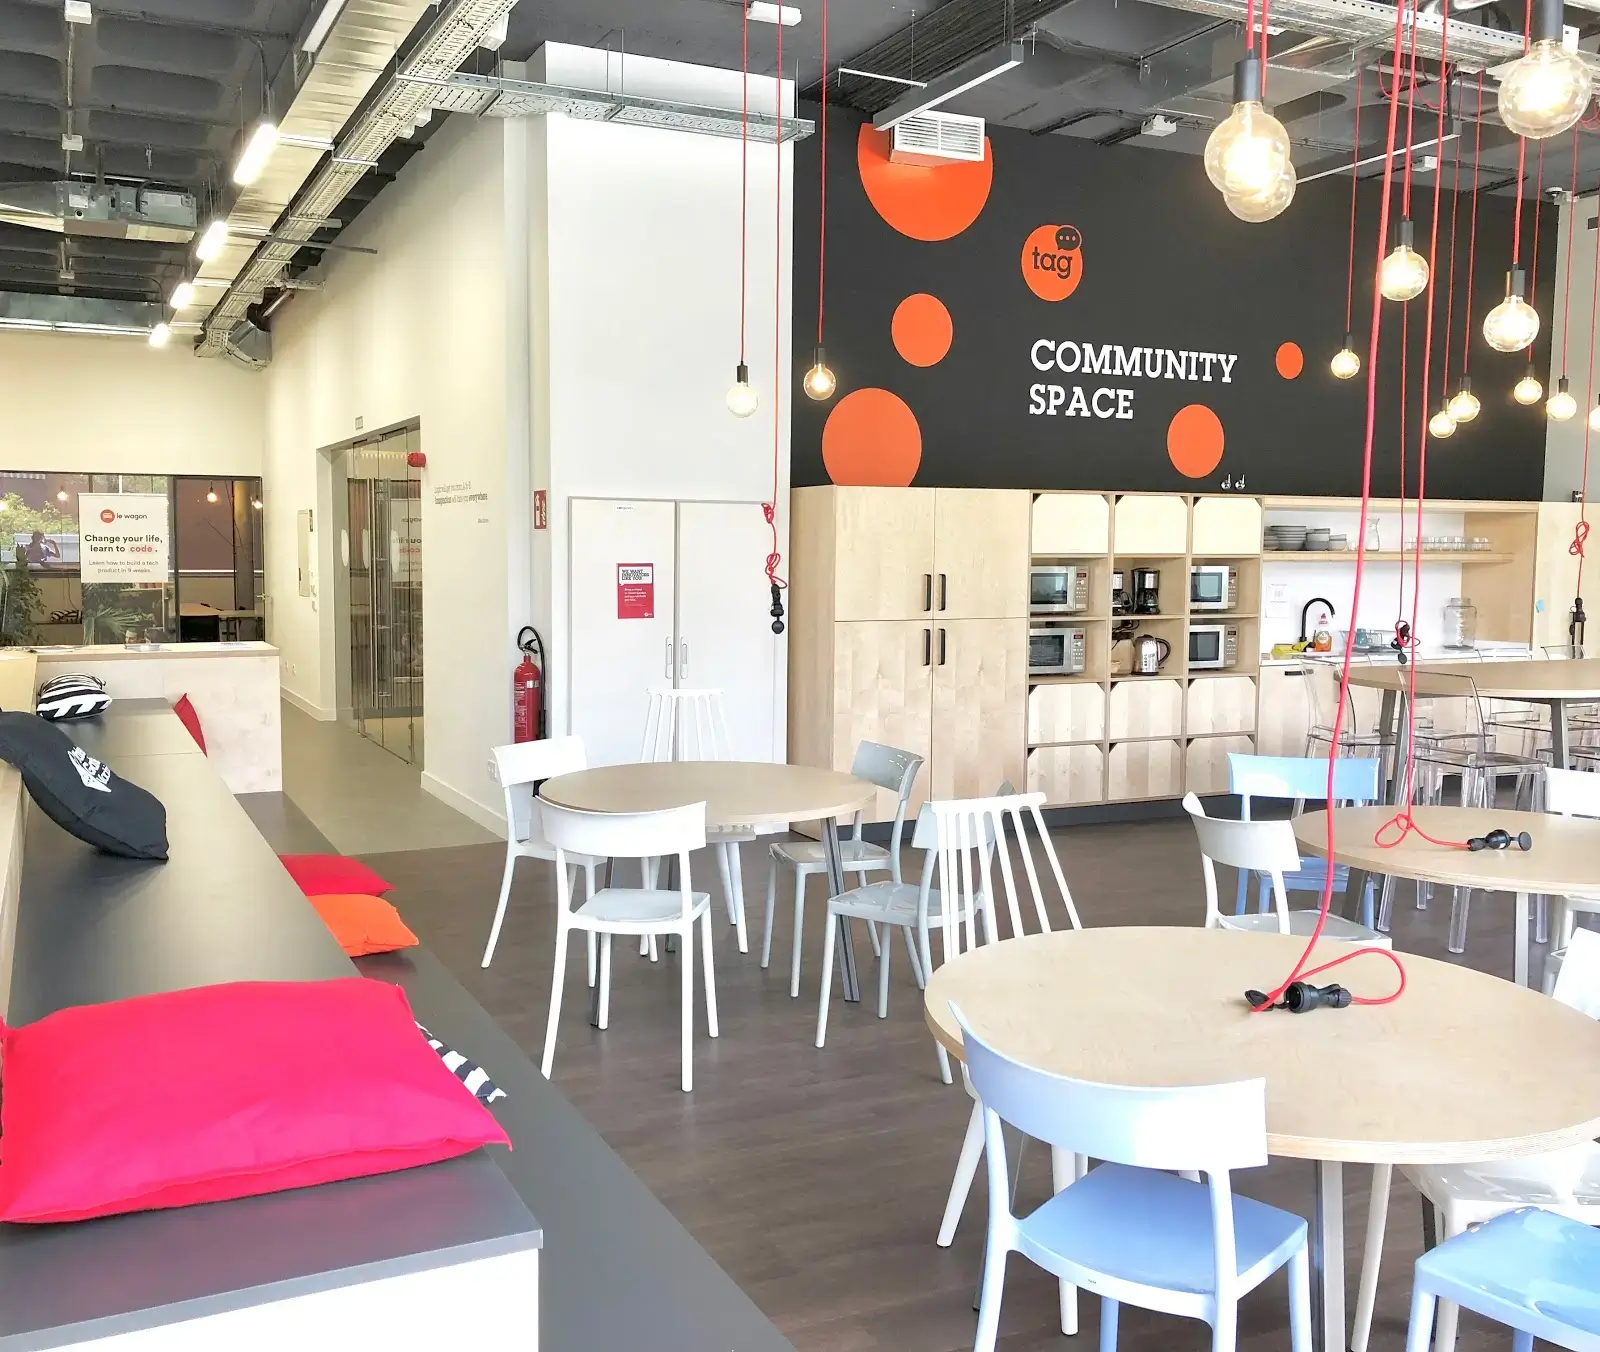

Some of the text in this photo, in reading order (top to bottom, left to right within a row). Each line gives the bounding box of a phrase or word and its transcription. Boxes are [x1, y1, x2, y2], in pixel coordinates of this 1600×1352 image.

[1032, 246, 1073, 280] tag
[1030, 338, 1238, 383] COMMUNITY
[1029, 383, 1134, 420] SPACE
[84, 534, 163, 544] Change your life,
[90, 544, 114, 552] learn
